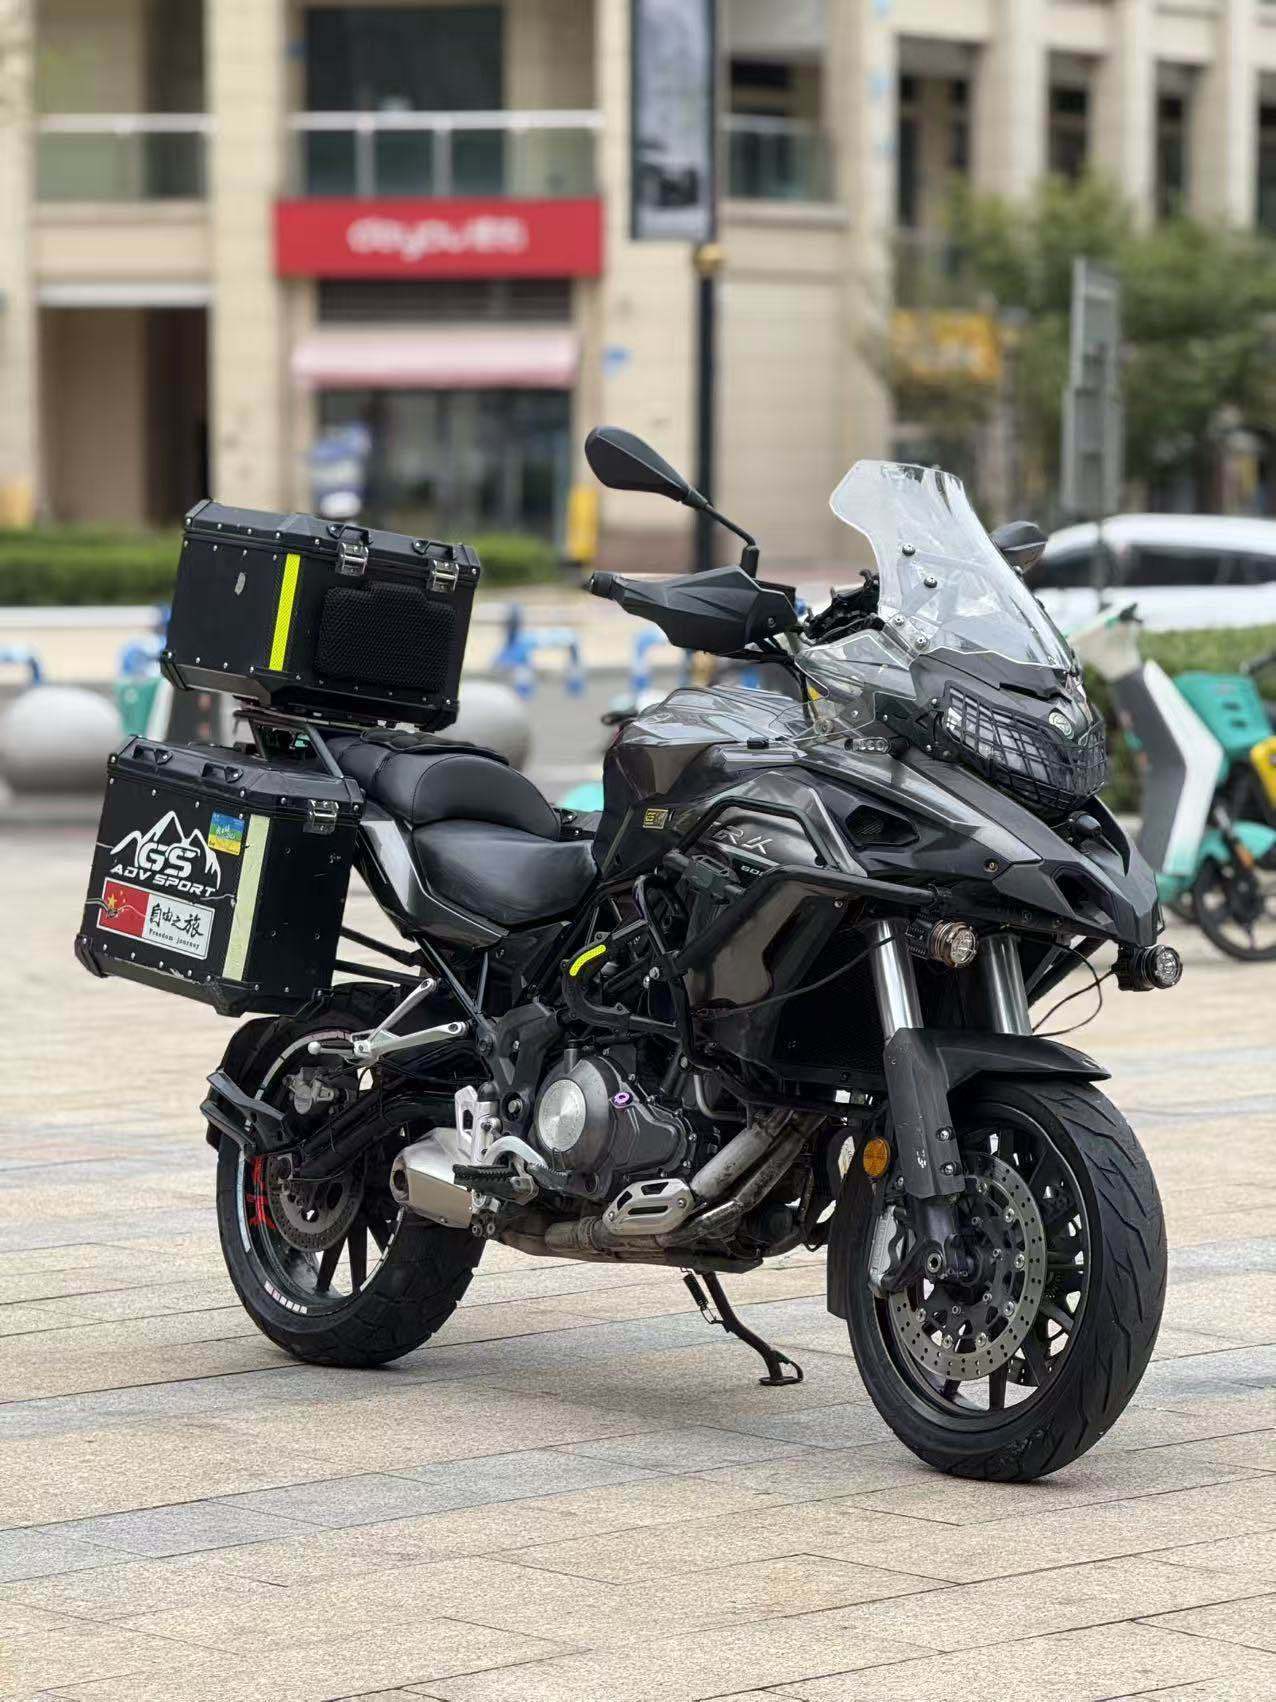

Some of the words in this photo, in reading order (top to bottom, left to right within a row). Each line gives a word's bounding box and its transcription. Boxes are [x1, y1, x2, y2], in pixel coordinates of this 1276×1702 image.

[711, 822, 773, 856] RK
[138, 841, 197, 879] GS
[110, 863, 152, 881] ADV
[152, 873, 216, 898] SPORT
[150, 902, 204, 938] 自由之旅
[149, 928, 174, 941] Freedom
[176, 936, 200, 950] journey
